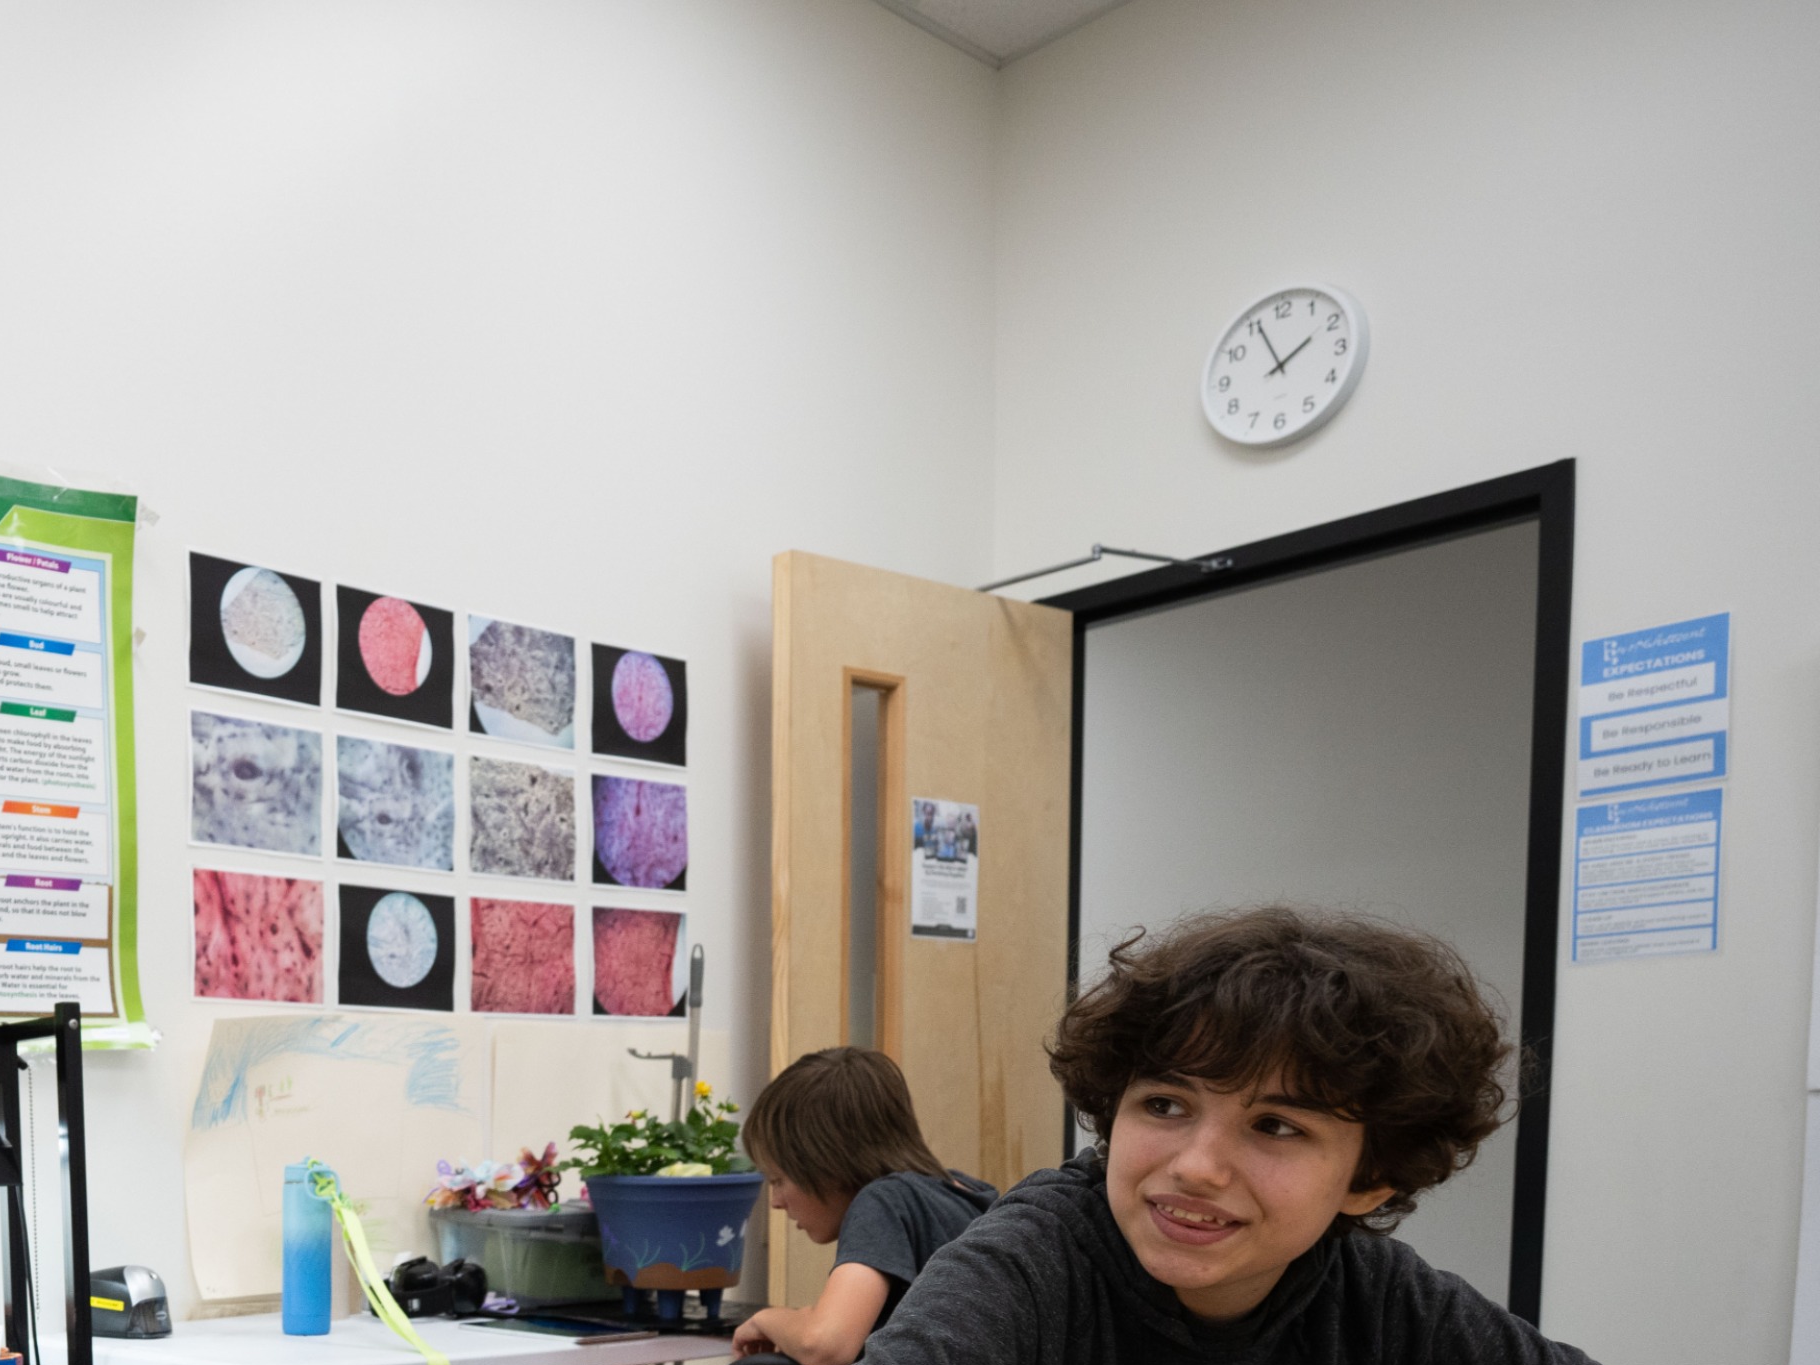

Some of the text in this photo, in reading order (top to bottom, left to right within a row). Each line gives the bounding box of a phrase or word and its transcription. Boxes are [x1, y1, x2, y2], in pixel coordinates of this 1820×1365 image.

[1274, 301, 1292, 319] 12
[1308, 300, 1315, 316] 1
[1248, 319, 1263, 336] 11
[1326, 313, 1340, 332] 2
[1228, 345, 1246, 363] 10
[1334, 338, 1347, 356] 3
[1218, 376, 1231, 392] 9
[1324, 368, 1337, 384] 4
[1227, 398, 1240, 415] 8
[1302, 396, 1315, 413] 5
[1248, 411, 1260, 429] 7
[1273, 413, 1286, 430] 6
[6, 552, 32, 565] Flower
[29, 640, 45, 649] Bud
[33, 664, 53, 672] leaves
[1602, 649, 1705, 678] EXPECTATIONS
[1607, 676, 1698, 702] Be Respectful
[30, 707, 47, 717] Leaf
[1602, 714, 1702, 740] Be Responsible
[1593, 752, 1711, 778] Be Ready to Learn
[32, 805, 51, 814] Stem
[35, 878, 52, 887] Root
[26, 942, 62, 952] Root Hairs
